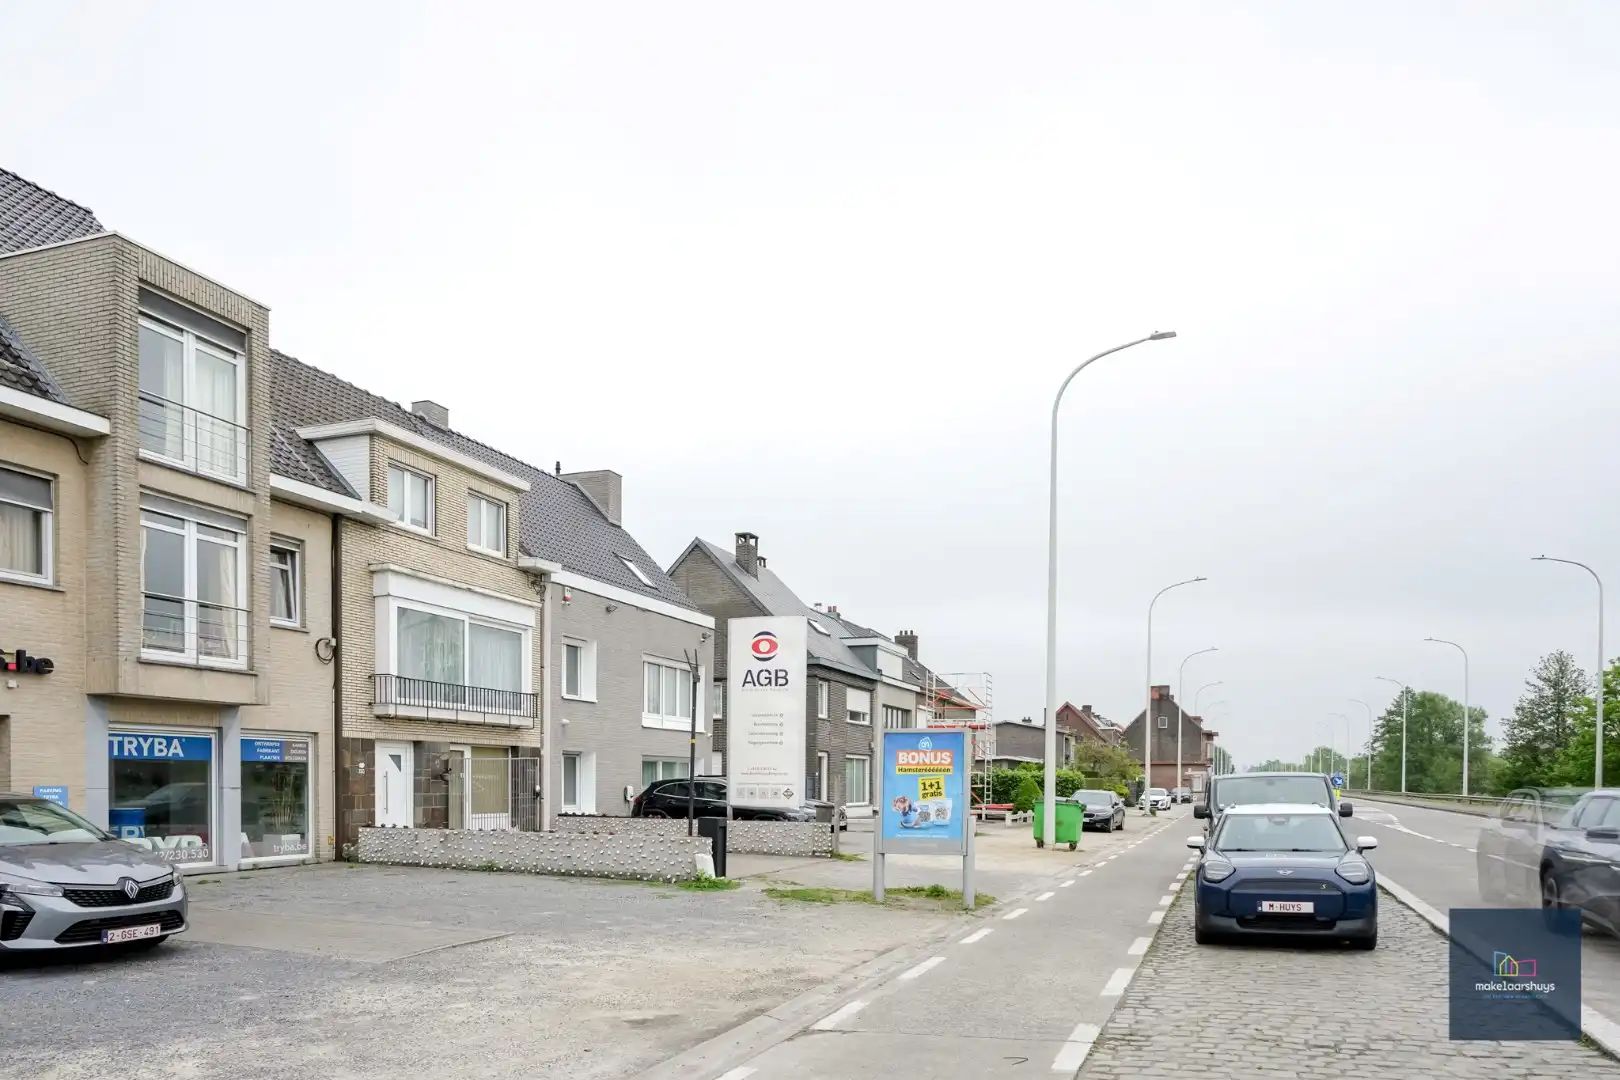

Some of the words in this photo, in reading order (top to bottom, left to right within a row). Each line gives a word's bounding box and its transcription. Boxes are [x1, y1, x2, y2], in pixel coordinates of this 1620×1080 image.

[741, 668, 789, 687] AGB
[108, 736, 184, 757] TRYBA
[898, 751, 952, 765] BONUS
[921, 780, 942, 791] 1+1
[921, 790, 943, 800] gratis
[273, 841, 307, 854] tryba.be
[109, 926, 160, 942] 2-GSE-491
